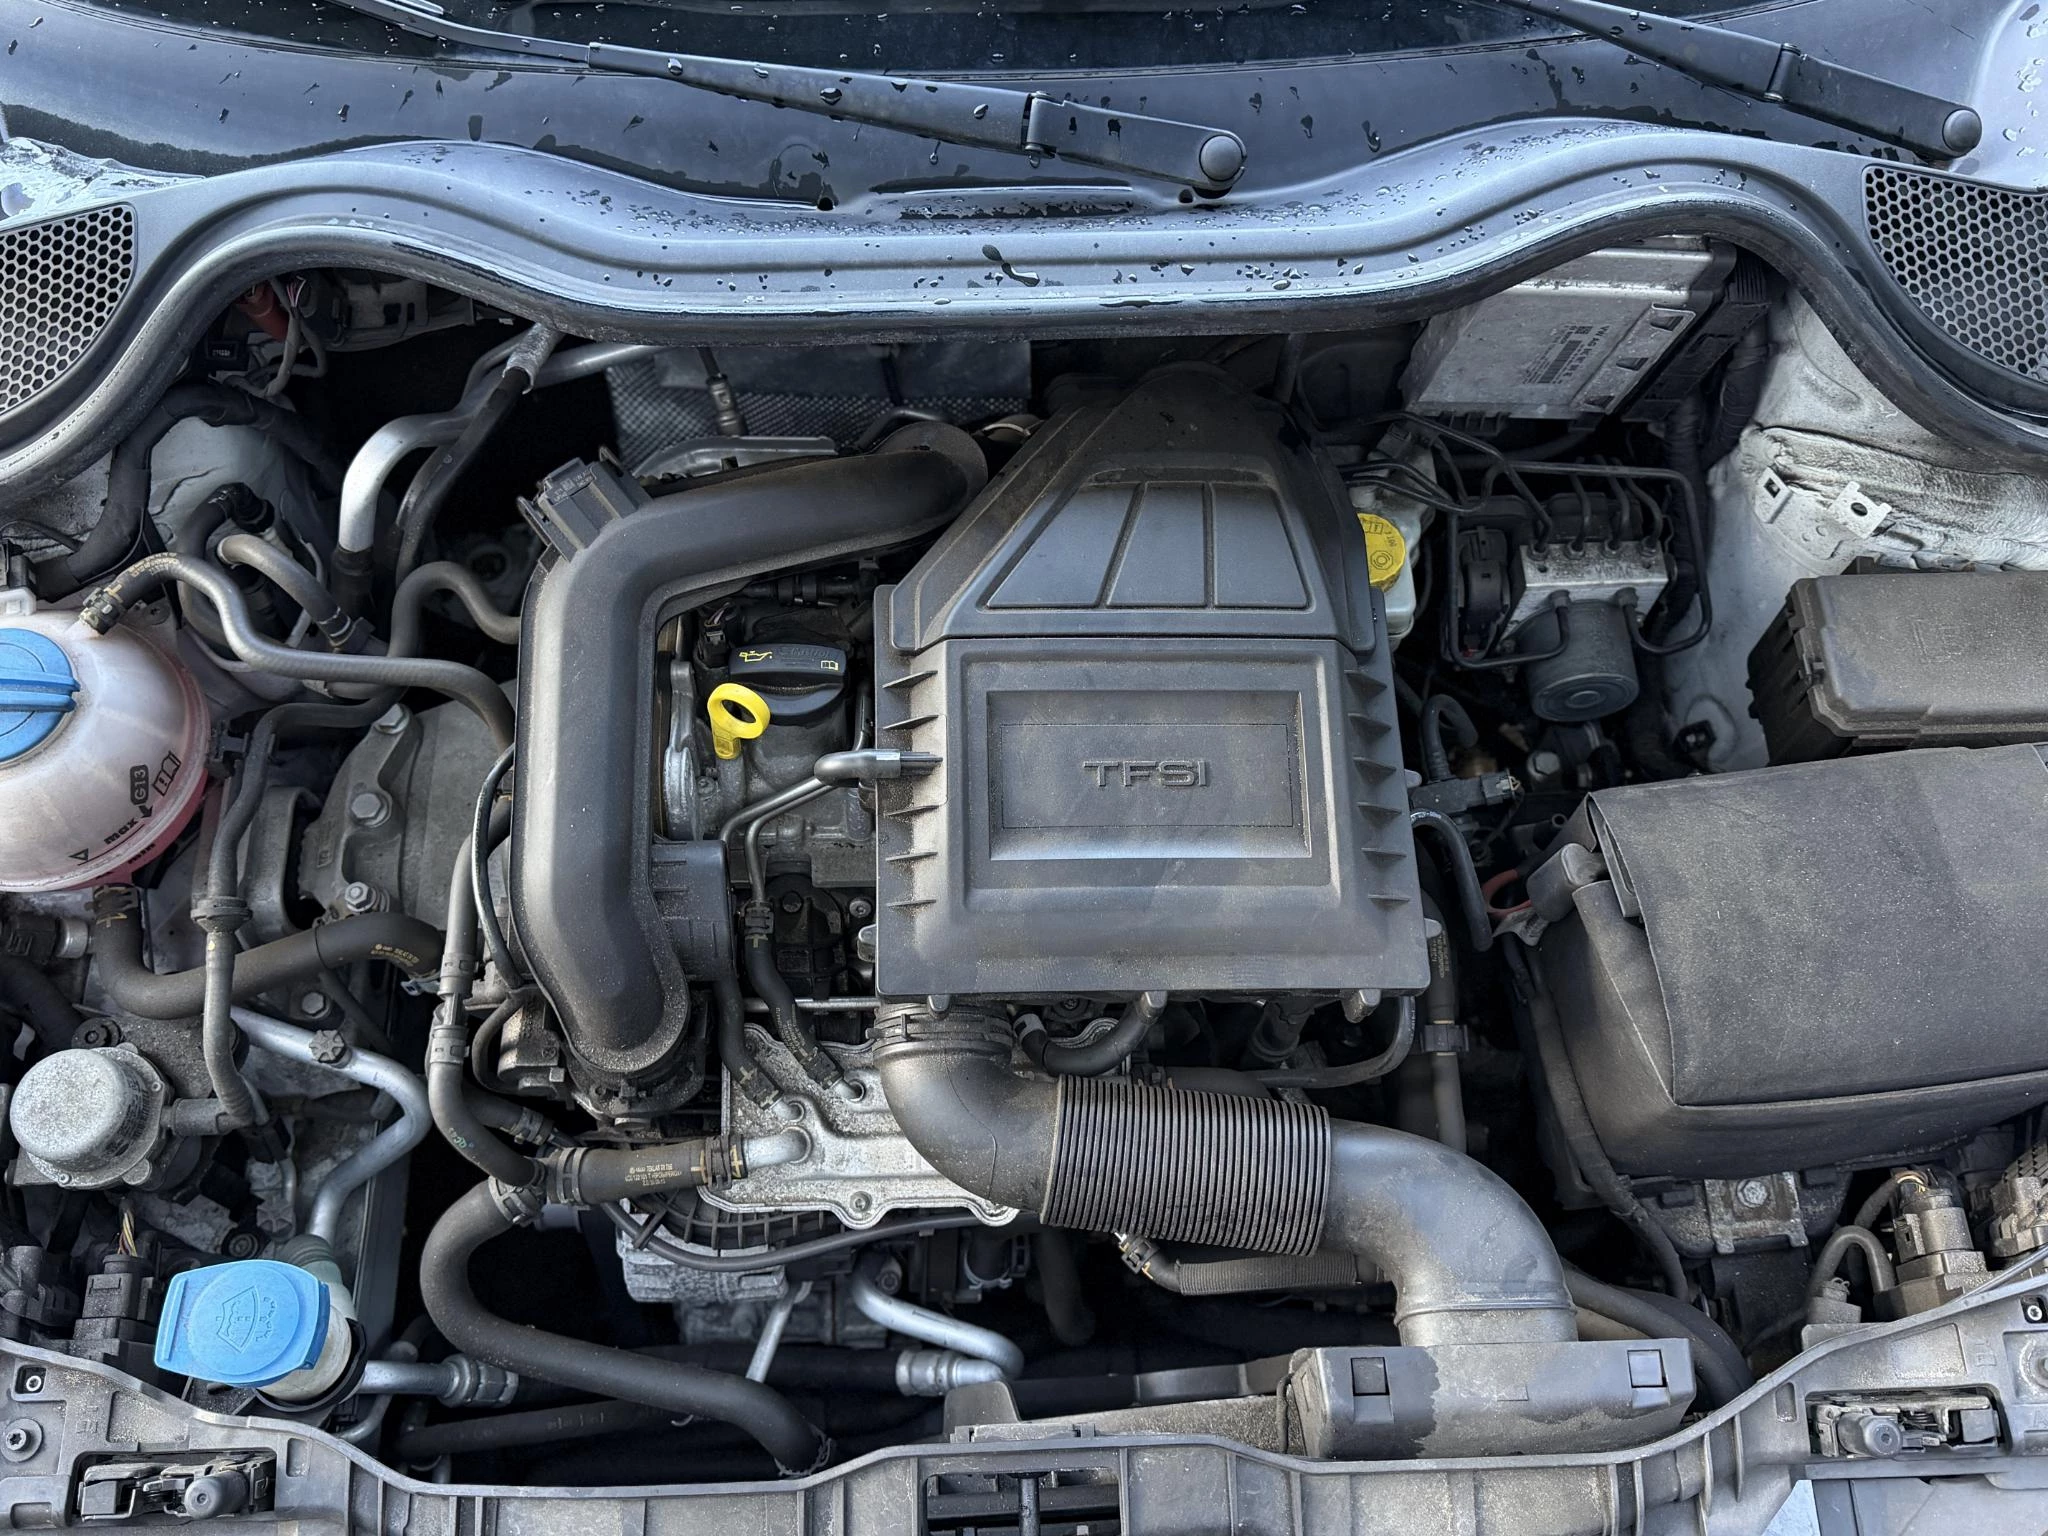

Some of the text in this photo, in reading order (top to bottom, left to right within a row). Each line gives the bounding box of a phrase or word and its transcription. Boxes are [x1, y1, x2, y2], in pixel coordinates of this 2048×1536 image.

[134, 770, 147, 801] G13
[1083, 759, 1208, 788] TFSI
[104, 818, 139, 845] max
